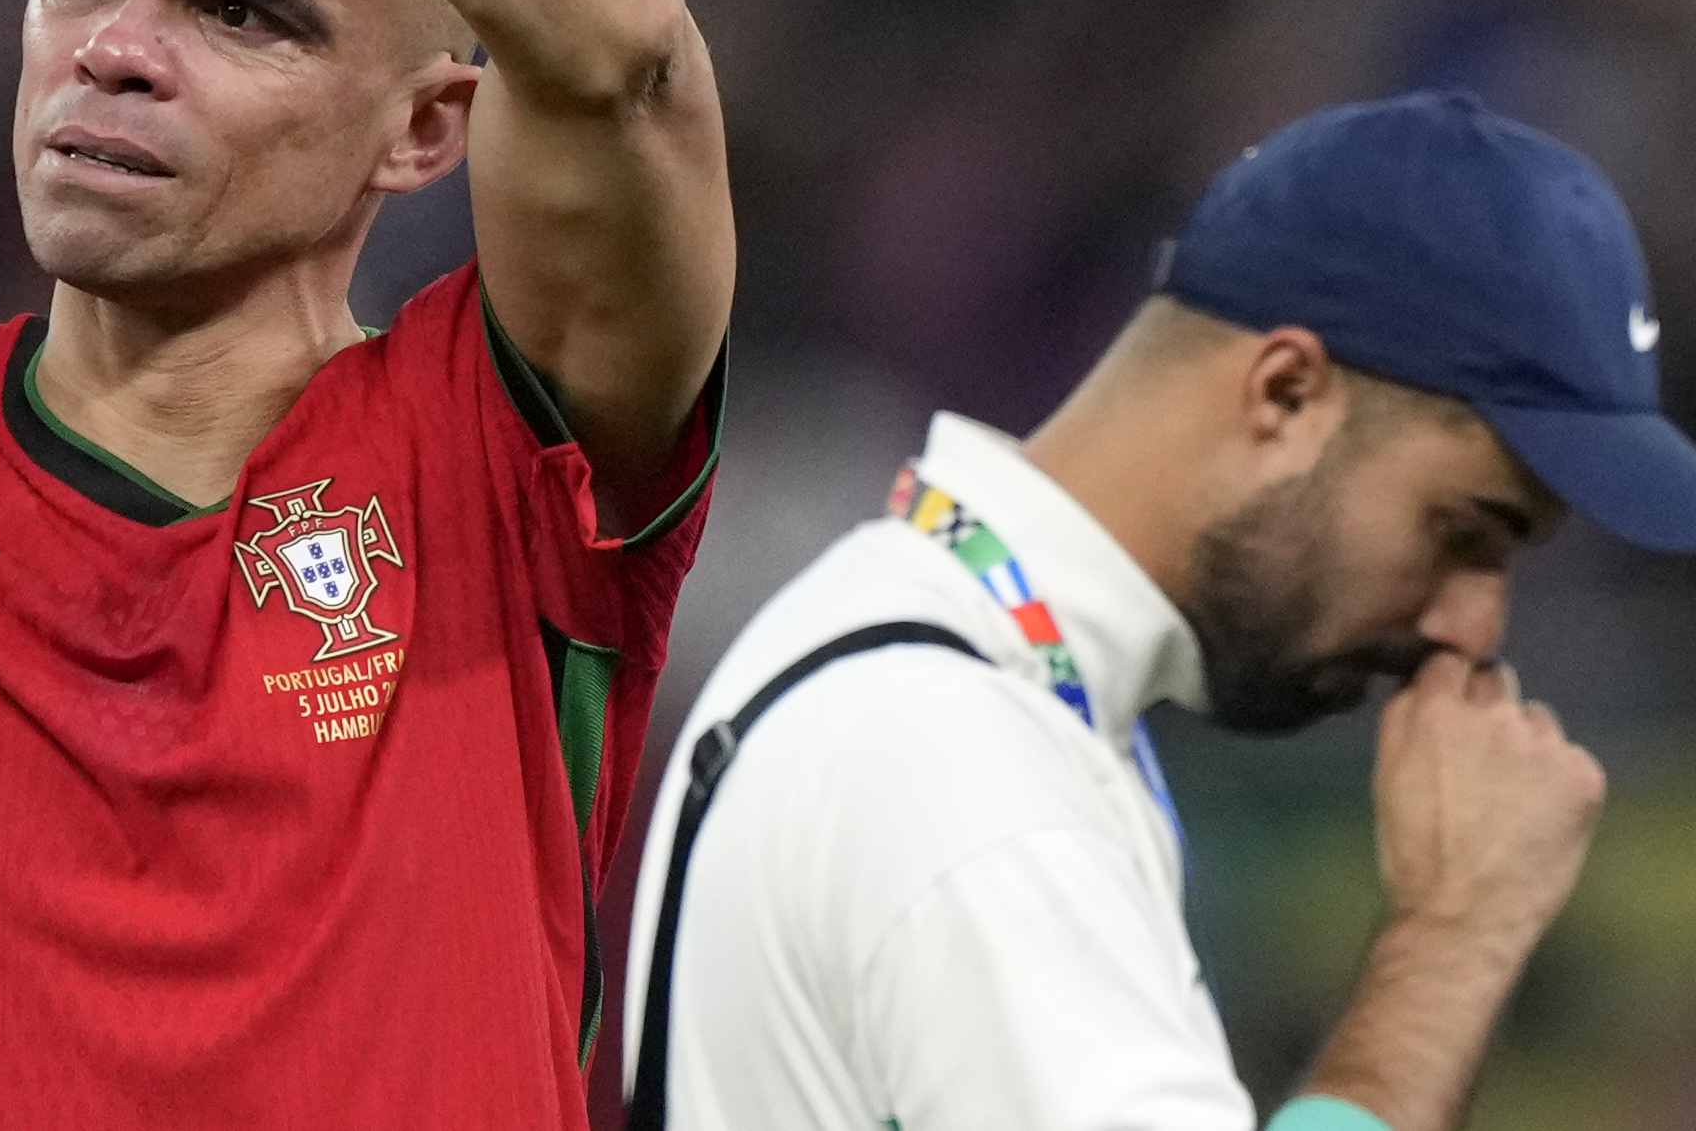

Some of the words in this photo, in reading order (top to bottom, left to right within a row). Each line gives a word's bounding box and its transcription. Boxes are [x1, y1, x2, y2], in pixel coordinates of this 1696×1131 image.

[287, 517, 327, 537] F.P.F.
[298, 695, 312, 718] 5
[316, 685, 379, 715] JULHO
